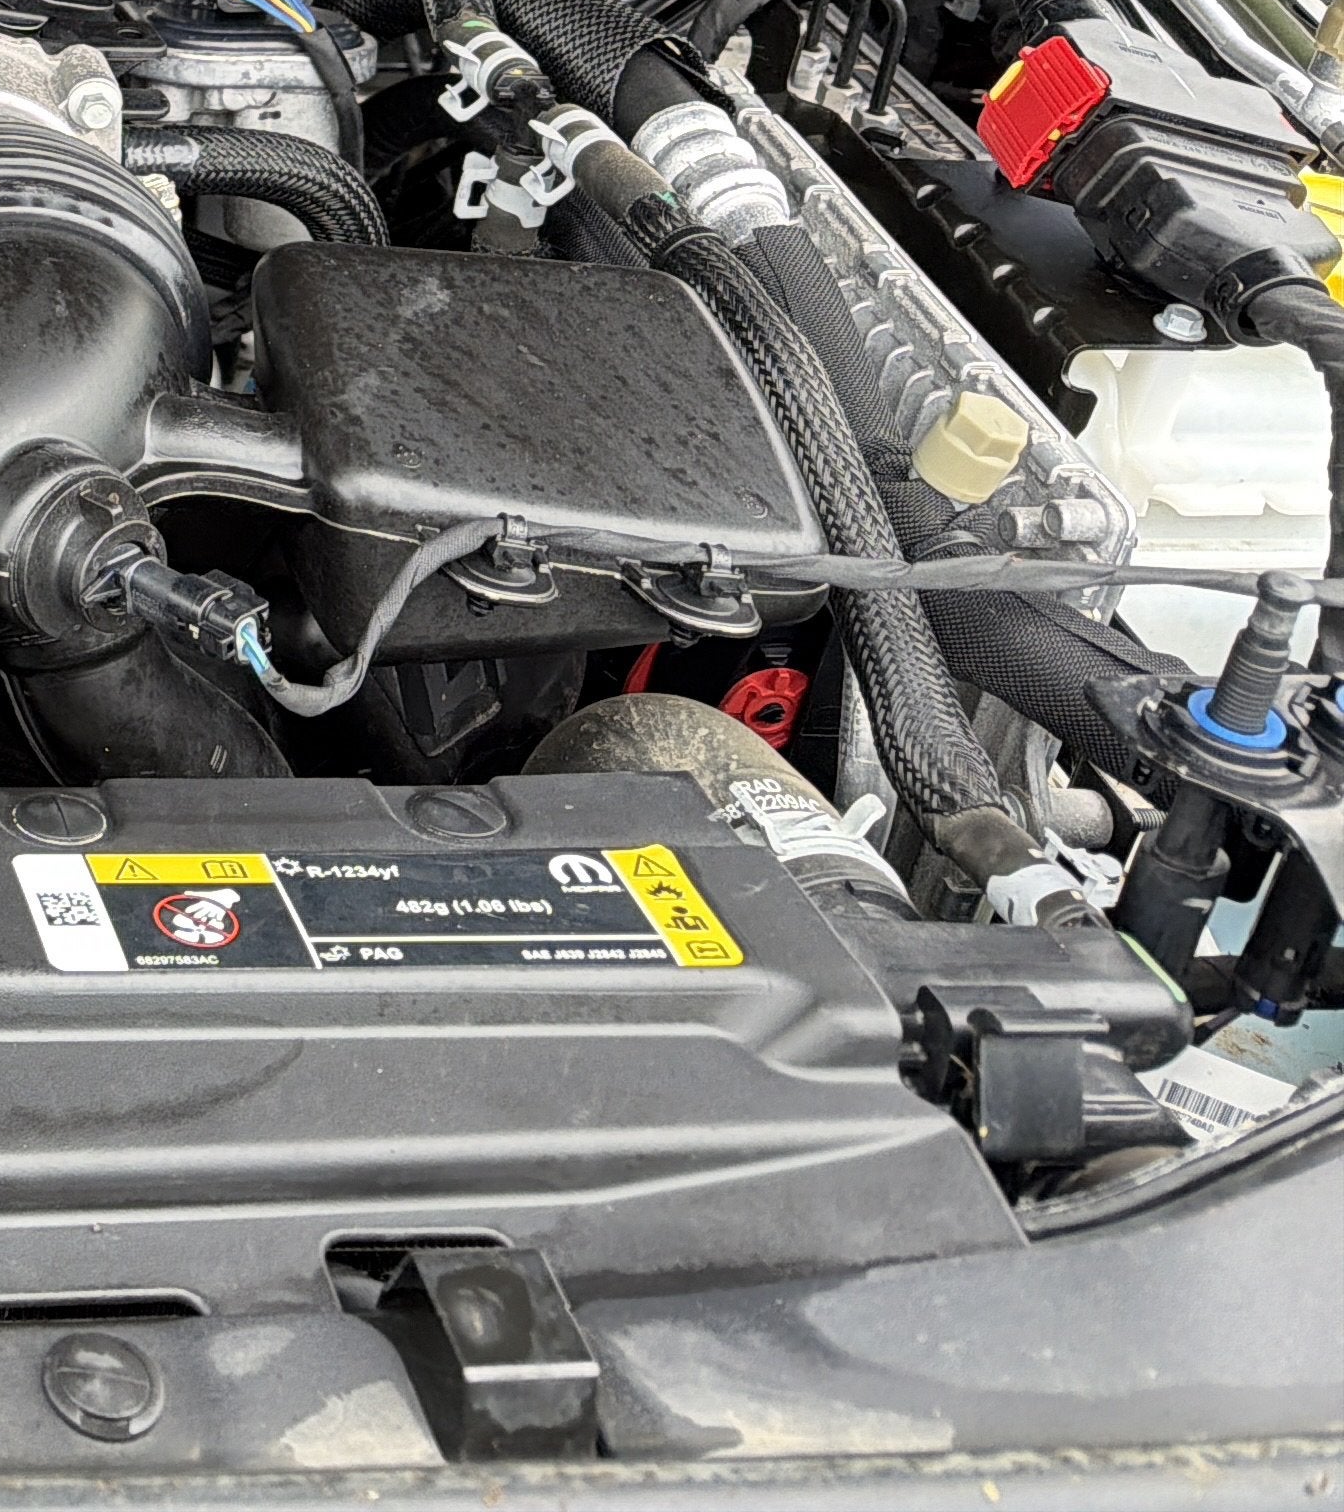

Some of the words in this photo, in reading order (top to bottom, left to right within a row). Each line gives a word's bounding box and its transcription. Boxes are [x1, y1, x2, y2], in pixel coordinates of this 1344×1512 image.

[305, 864, 400, 881] R-1234yf
[395, 899, 450, 916] 482g
[508, 898, 553, 916] lbs)
[359, 946, 404, 961] PAG
